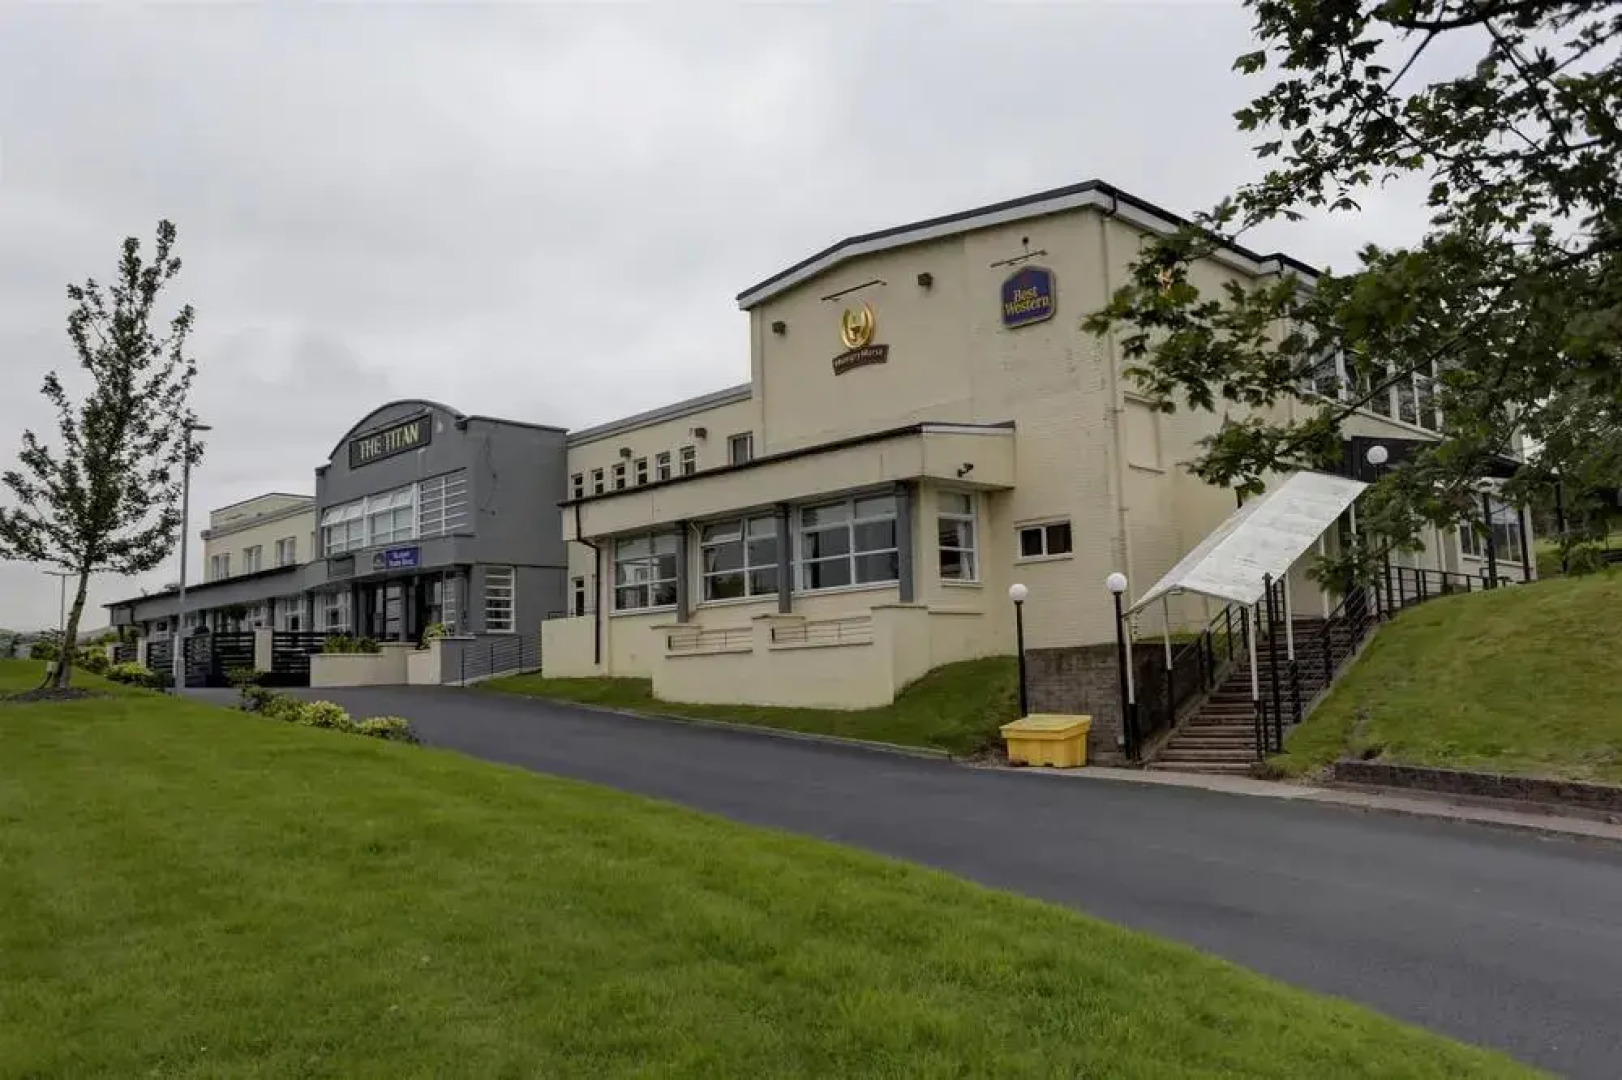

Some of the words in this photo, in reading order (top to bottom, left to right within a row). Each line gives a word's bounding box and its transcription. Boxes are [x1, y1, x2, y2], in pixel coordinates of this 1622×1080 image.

[1014, 286, 1038, 302] Best
[1004, 296, 1049, 315] Western
[361, 435, 381, 460] THE
[383, 421, 419, 454] TITAN
